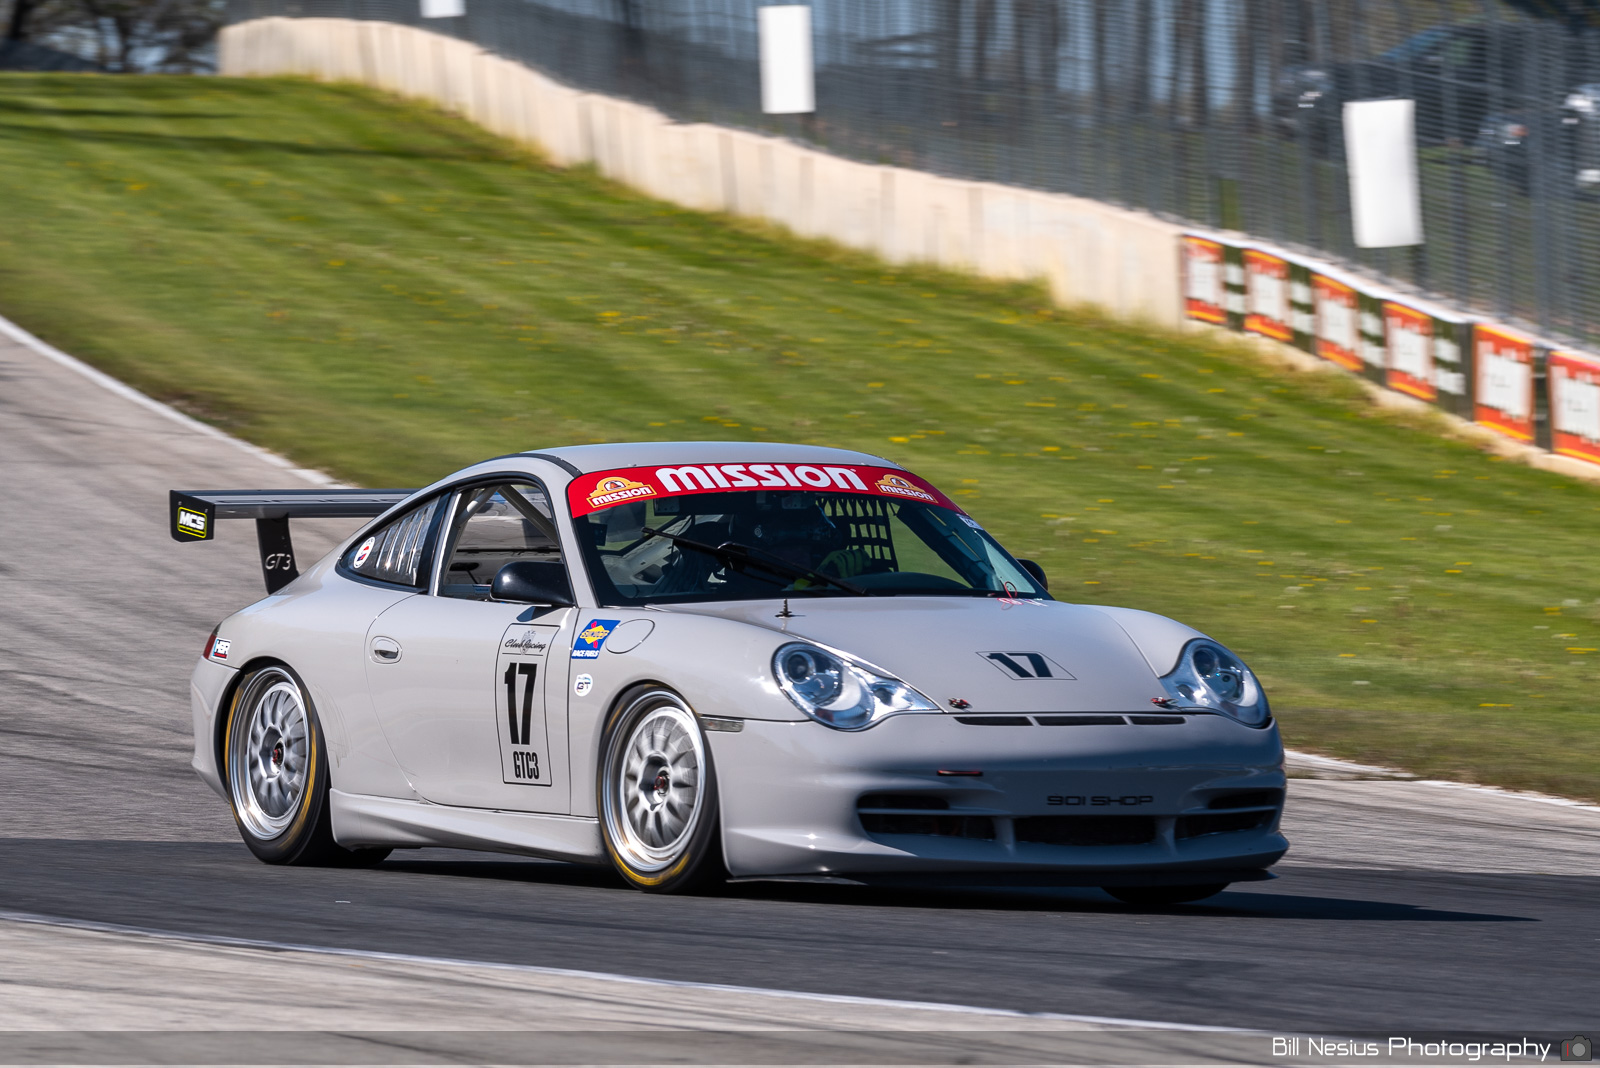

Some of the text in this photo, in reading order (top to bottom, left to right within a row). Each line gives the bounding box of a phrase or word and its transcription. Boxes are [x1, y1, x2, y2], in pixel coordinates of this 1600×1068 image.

[179, 511, 205, 530] MCS
[265, 553, 291, 570] GT3
[985, 653, 1053, 678] 17
[504, 662, 537, 745] 17
[513, 751, 539, 780] GTC3
[1046, 795, 1153, 806] 901 SHOP
